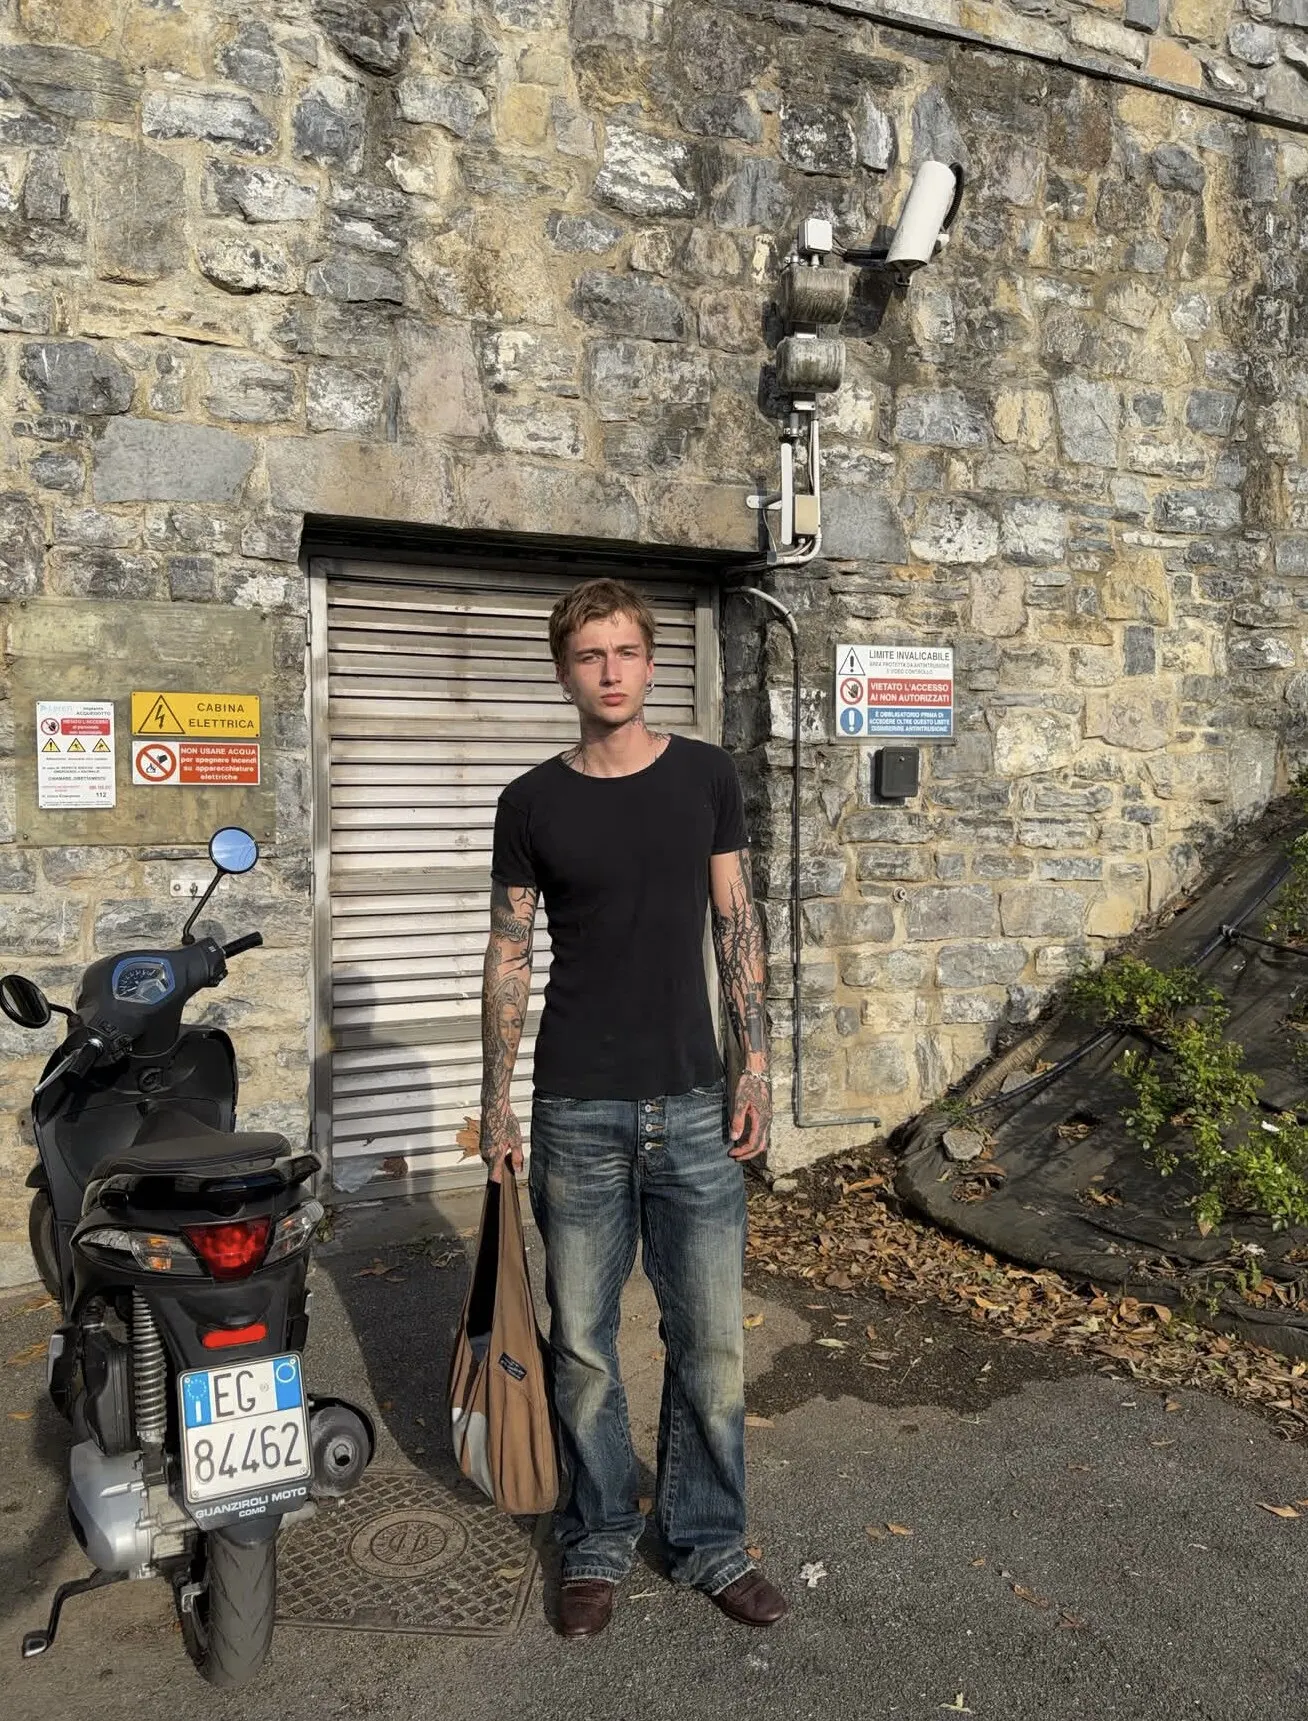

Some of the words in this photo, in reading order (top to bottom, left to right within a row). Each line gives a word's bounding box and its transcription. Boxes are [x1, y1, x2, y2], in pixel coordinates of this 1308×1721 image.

[869, 650, 894, 660] LIMITE
[897, 651, 950, 660] INVALICABILE
[870, 682, 902, 691] VIETATO
[904, 683, 949, 692] L'ACCESSO
[197, 703, 244, 712] CABINA
[189, 719, 254, 729] ELETTRICA
[213, 1370, 256, 1418] EG
[194, 1422, 302, 1483] 84462
[195, 1495, 269, 1519] GUANZIROLI
[272, 1487, 307, 1502] MOTO
[238, 1506, 266, 1518] COMO
